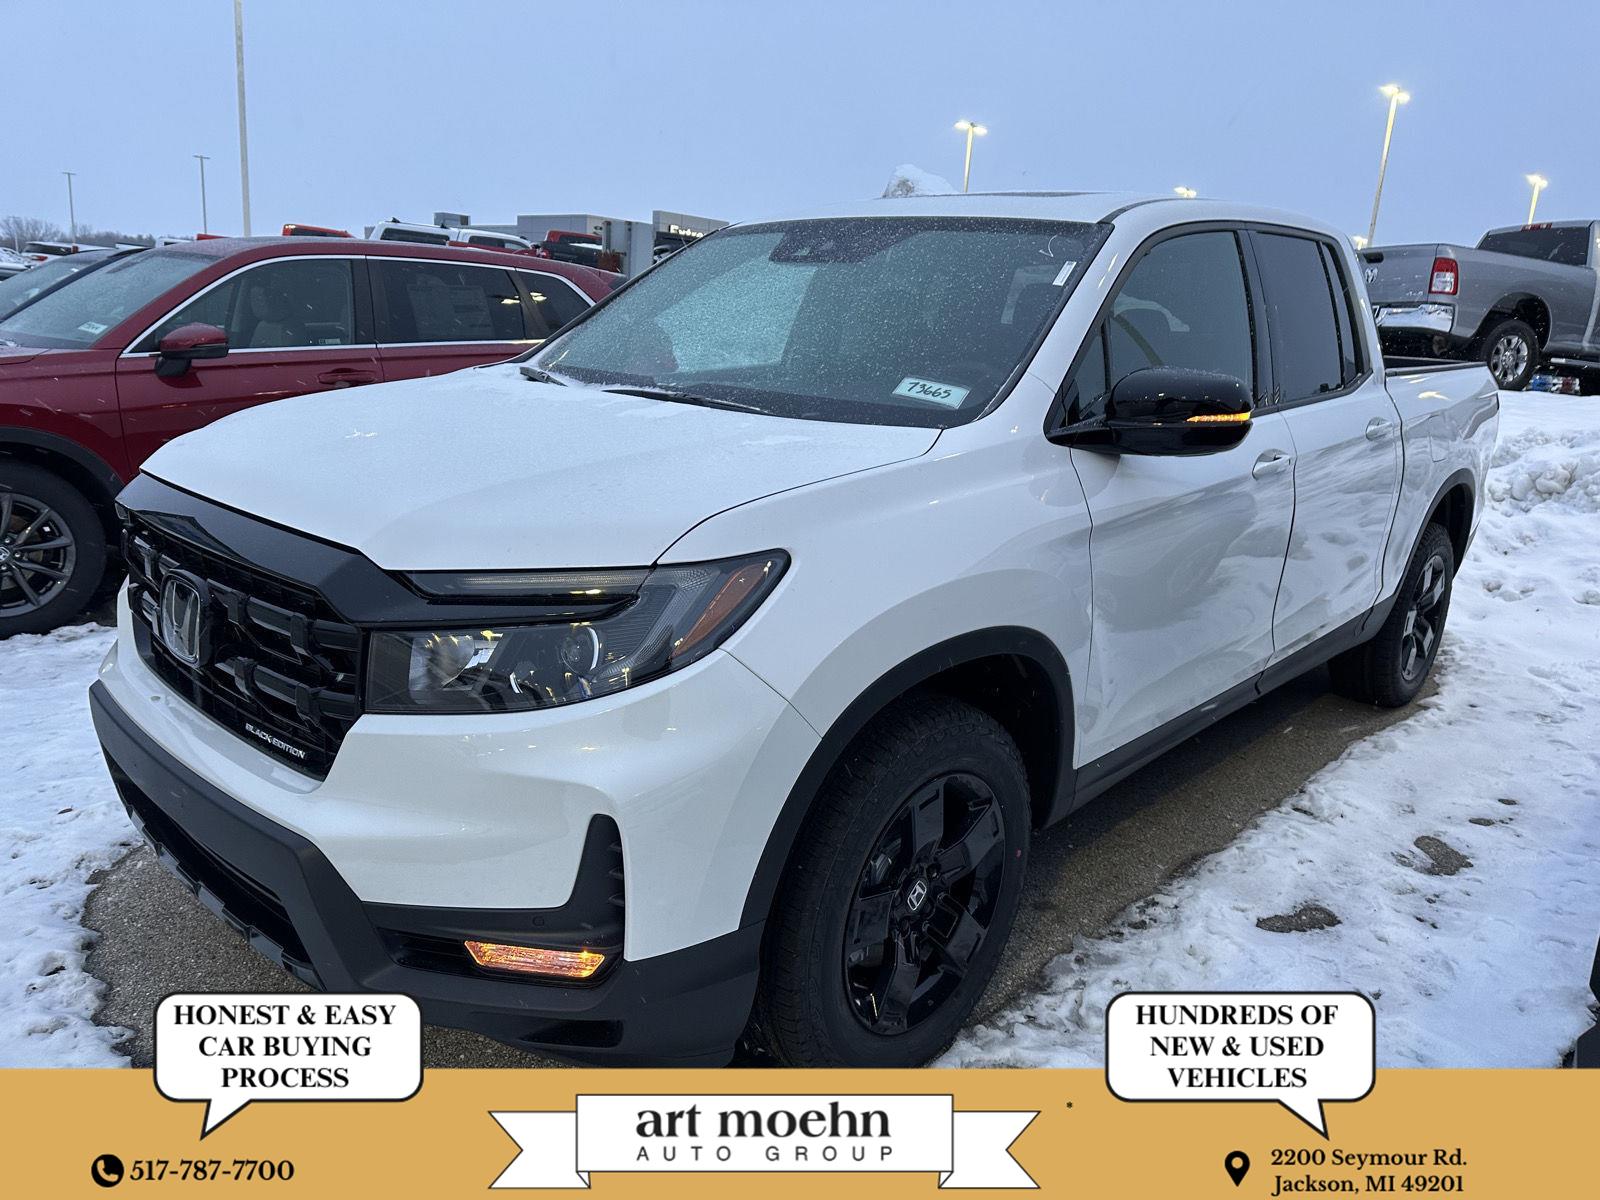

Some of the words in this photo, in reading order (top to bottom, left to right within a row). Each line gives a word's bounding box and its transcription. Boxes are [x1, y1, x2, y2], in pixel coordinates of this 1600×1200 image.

[907, 381, 952, 399] 73665
[245, 722, 273, 744] BLACK
[272, 737, 306, 759] EDITION
